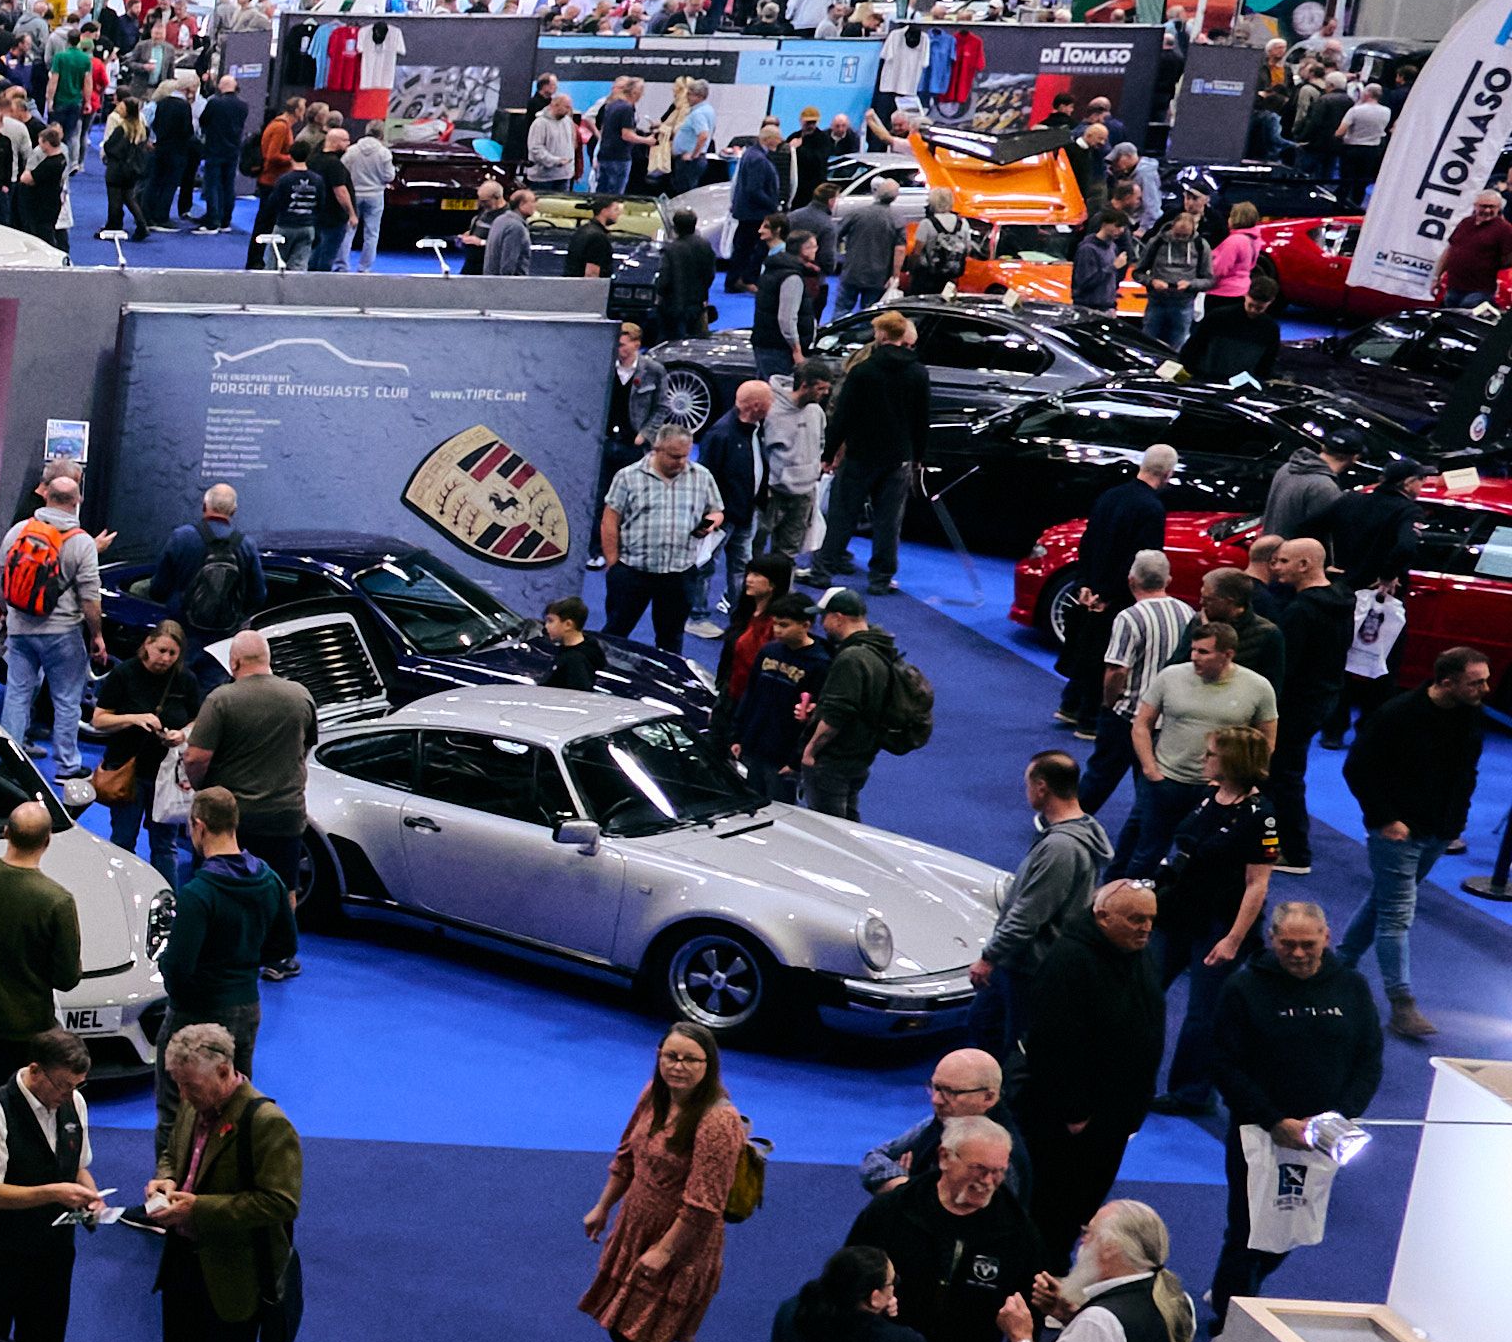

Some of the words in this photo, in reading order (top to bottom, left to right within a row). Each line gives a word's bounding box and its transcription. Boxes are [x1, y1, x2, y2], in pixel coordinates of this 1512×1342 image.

[759, 59, 774, 67] DE
[776, 54, 835, 68] TOMASO
[1040, 46, 1060, 64] DE
[1060, 42, 1134, 64] TOMASO
[1416, 59, 1512, 202] TOMASO
[1416, 203, 1454, 242] DE
[1375, 250, 1389, 261] DE
[1388, 249, 1436, 273] TOMASO
[210, 382, 271, 395] PORSCHE
[277, 384, 369, 398] ENTHUSIASTS
[375, 385, 409, 399] CLUB
[430, 388, 528, 402] www.TIPEC.net
[67, 1010, 103, 1029] NEL
